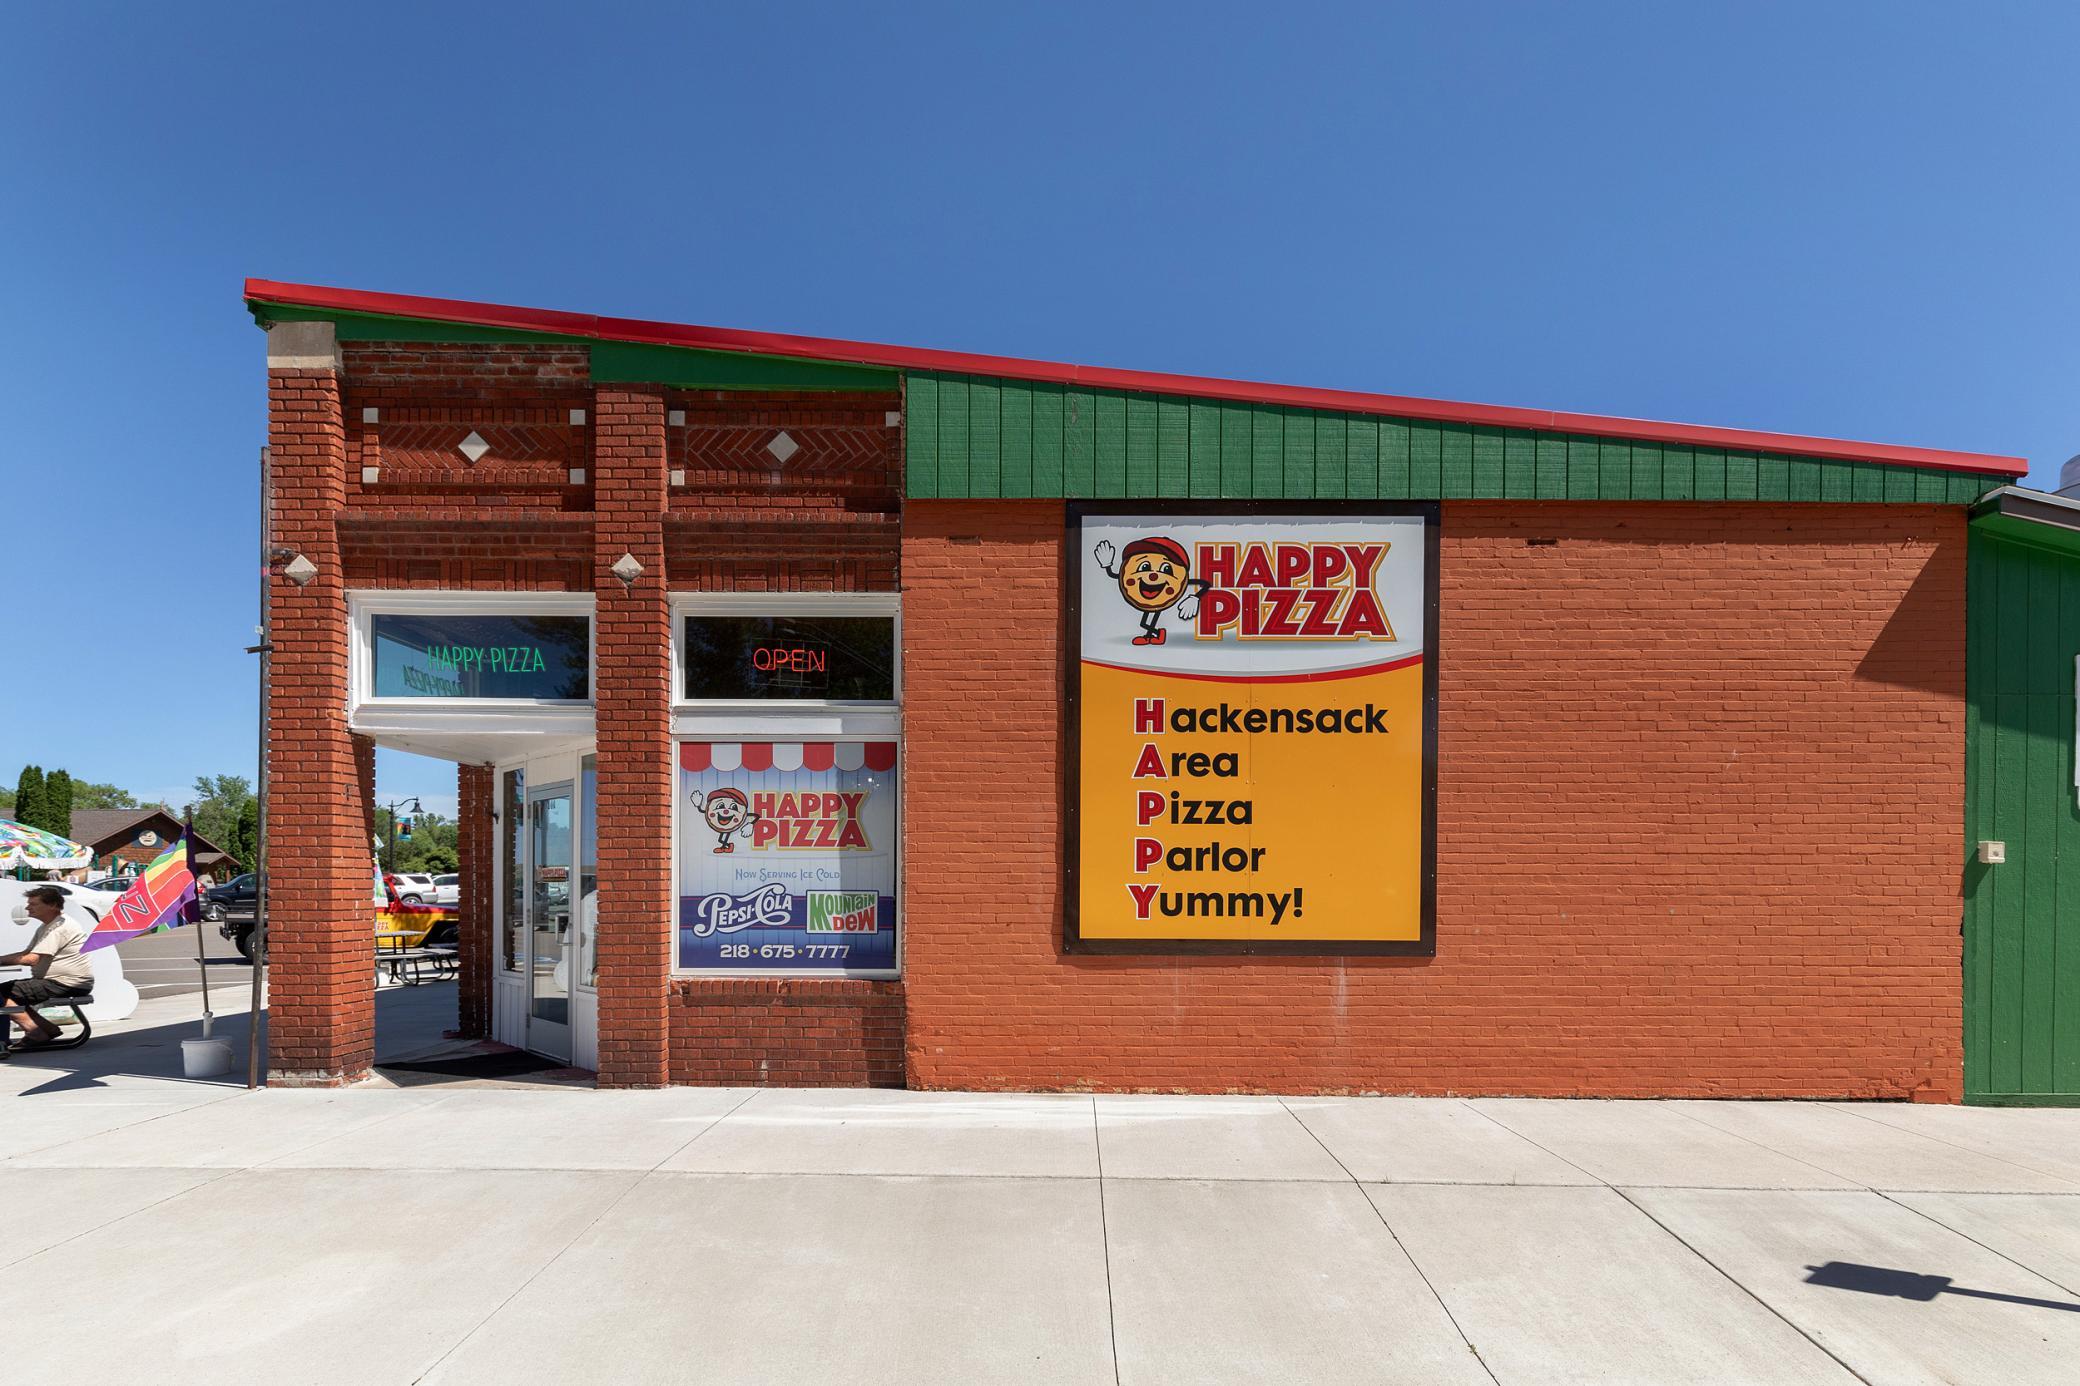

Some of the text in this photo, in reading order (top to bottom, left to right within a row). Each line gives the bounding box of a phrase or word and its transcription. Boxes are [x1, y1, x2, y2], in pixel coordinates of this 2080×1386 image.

[1197, 543, 1386, 589] HAPPY
[1197, 587, 1391, 637] PIZZA
[427, 646, 546, 672] HAPPY PIZZA
[753, 647, 825, 672] OPEN
[1134, 698, 1389, 735] Hackensack
[1131, 742, 1239, 780] Area
[753, 792, 865, 819] HAPPY
[1136, 790, 1252, 827] Pizza
[753, 818, 867, 848] PIZZA
[1134, 836, 1266, 874] Parlor
[1125, 883, 1303, 926] Yummy!
